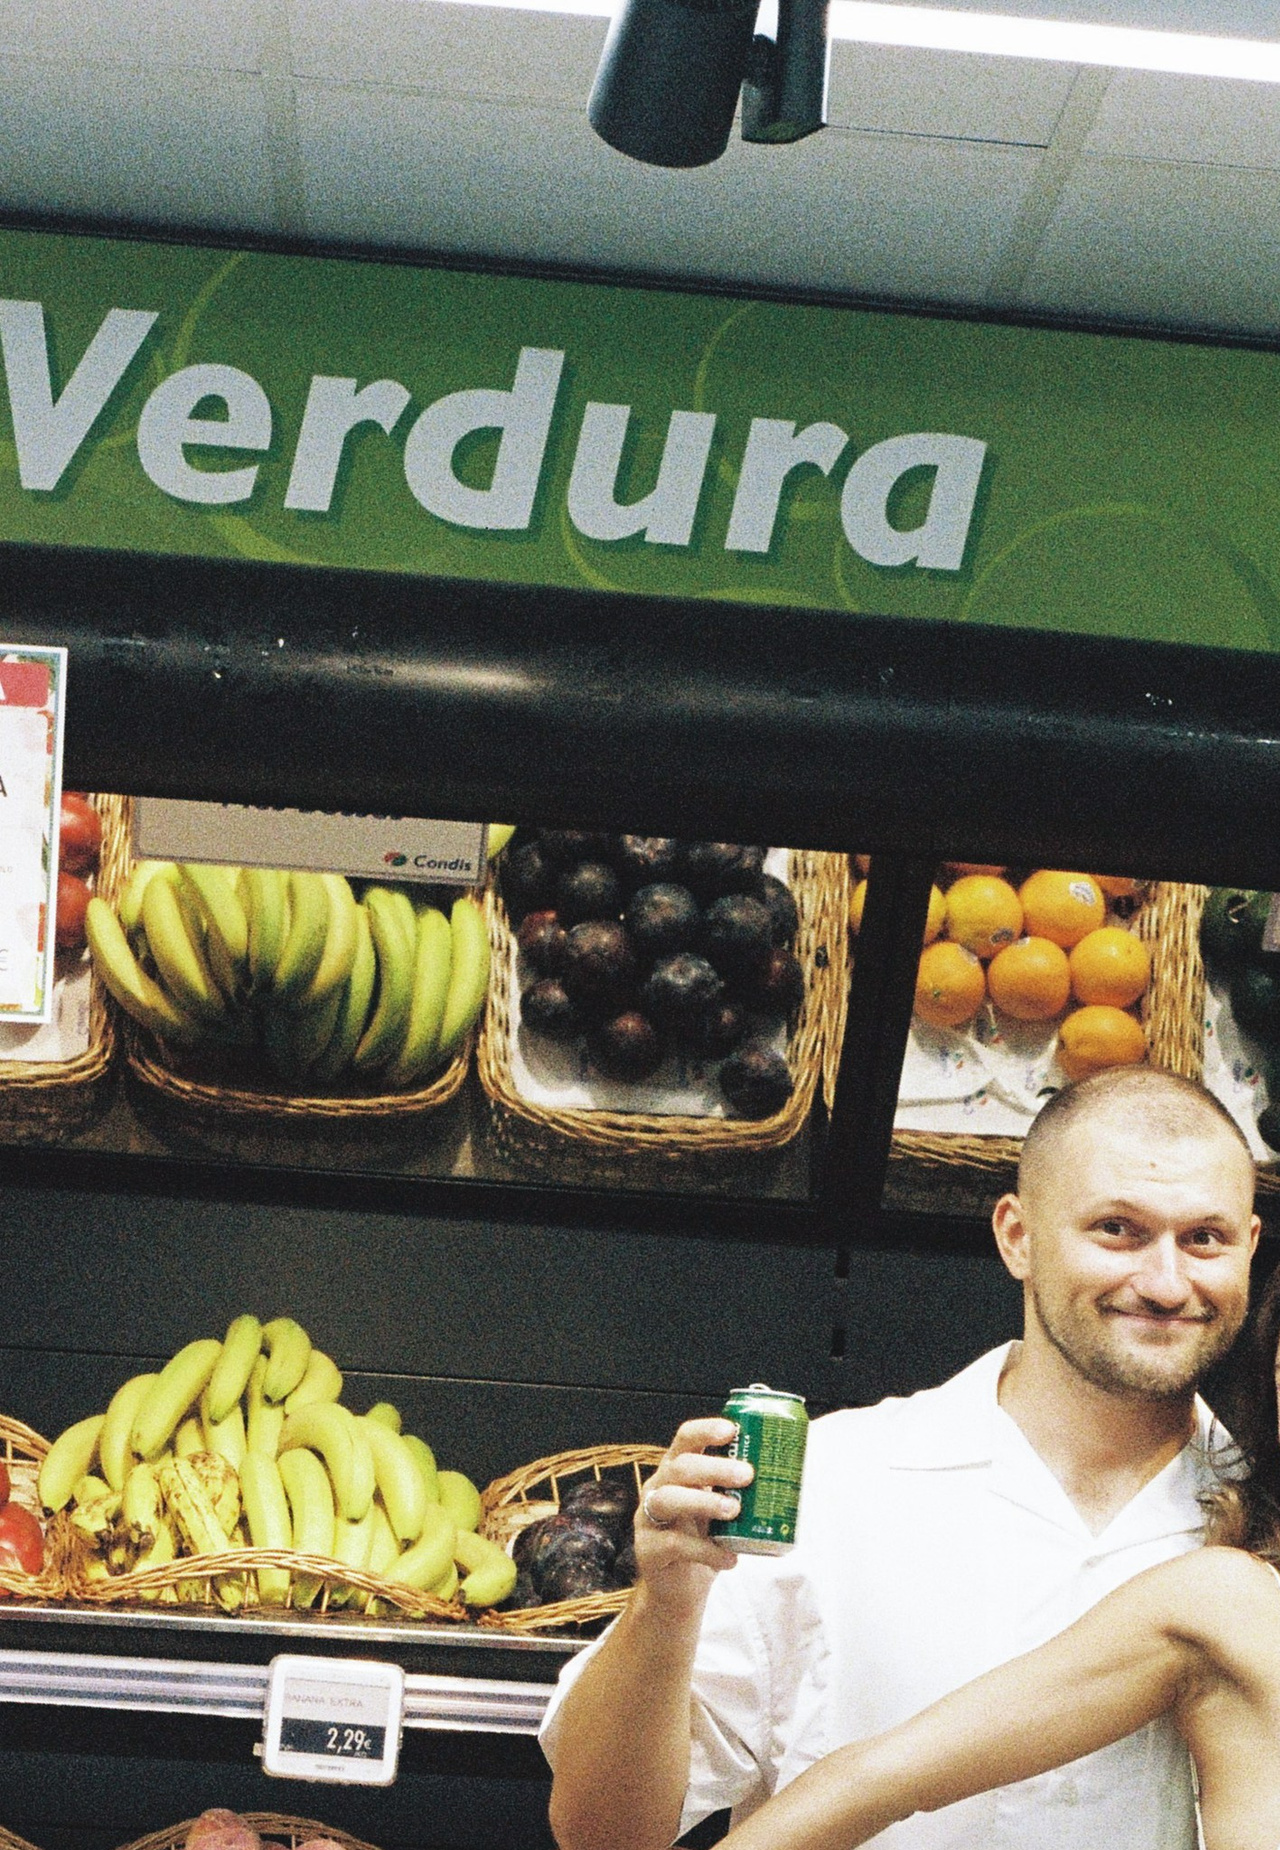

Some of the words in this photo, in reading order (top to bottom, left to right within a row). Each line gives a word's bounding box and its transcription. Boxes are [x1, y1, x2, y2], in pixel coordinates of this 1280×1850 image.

[0, 298, 988, 572] Verdura
[413, 854, 472, 872] Condis
[329, 1696, 364, 1708] EXTRA
[326, 1727, 372, 1755] 2,29€
